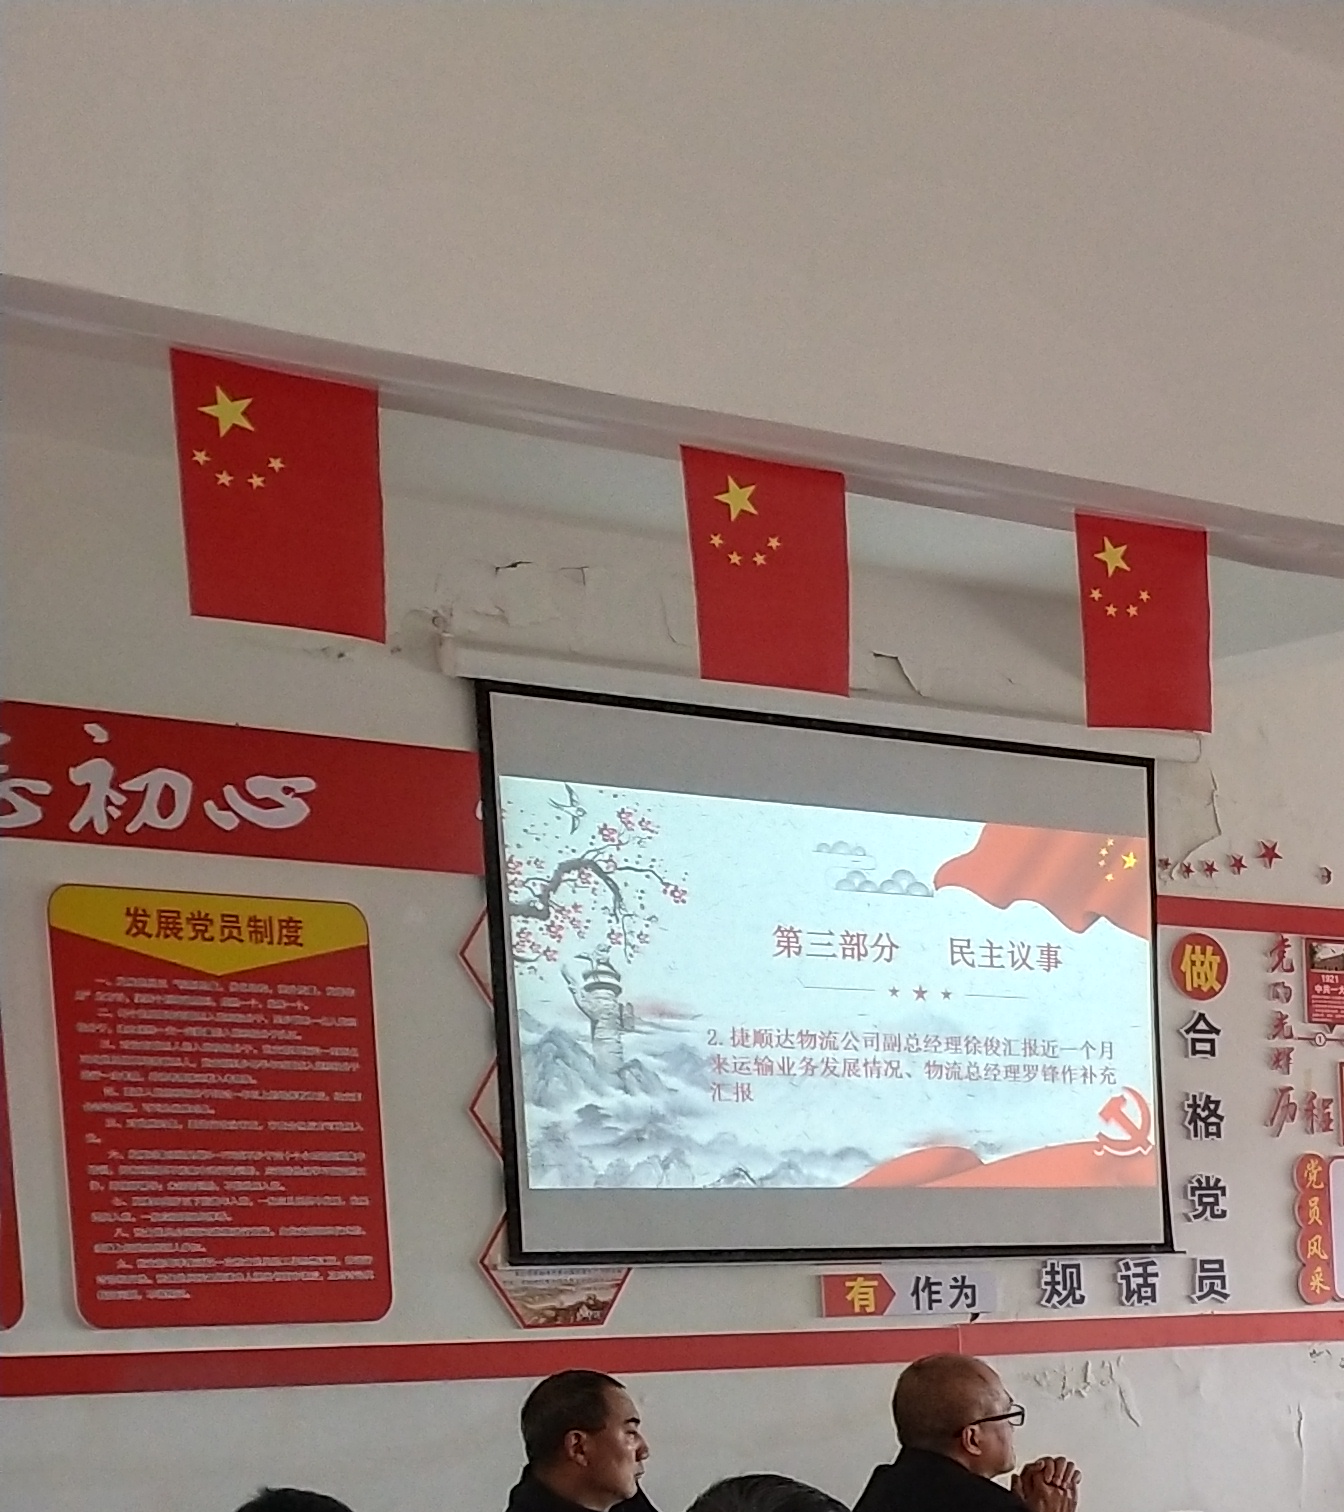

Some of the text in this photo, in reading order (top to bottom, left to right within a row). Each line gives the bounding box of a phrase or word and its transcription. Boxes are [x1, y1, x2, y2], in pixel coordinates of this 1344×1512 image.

[123, 905, 305, 949] 发展党员制度
[772, 925, 1063, 973] 第三部分 民主议事
[710, 1081, 755, 1103] 汇报
